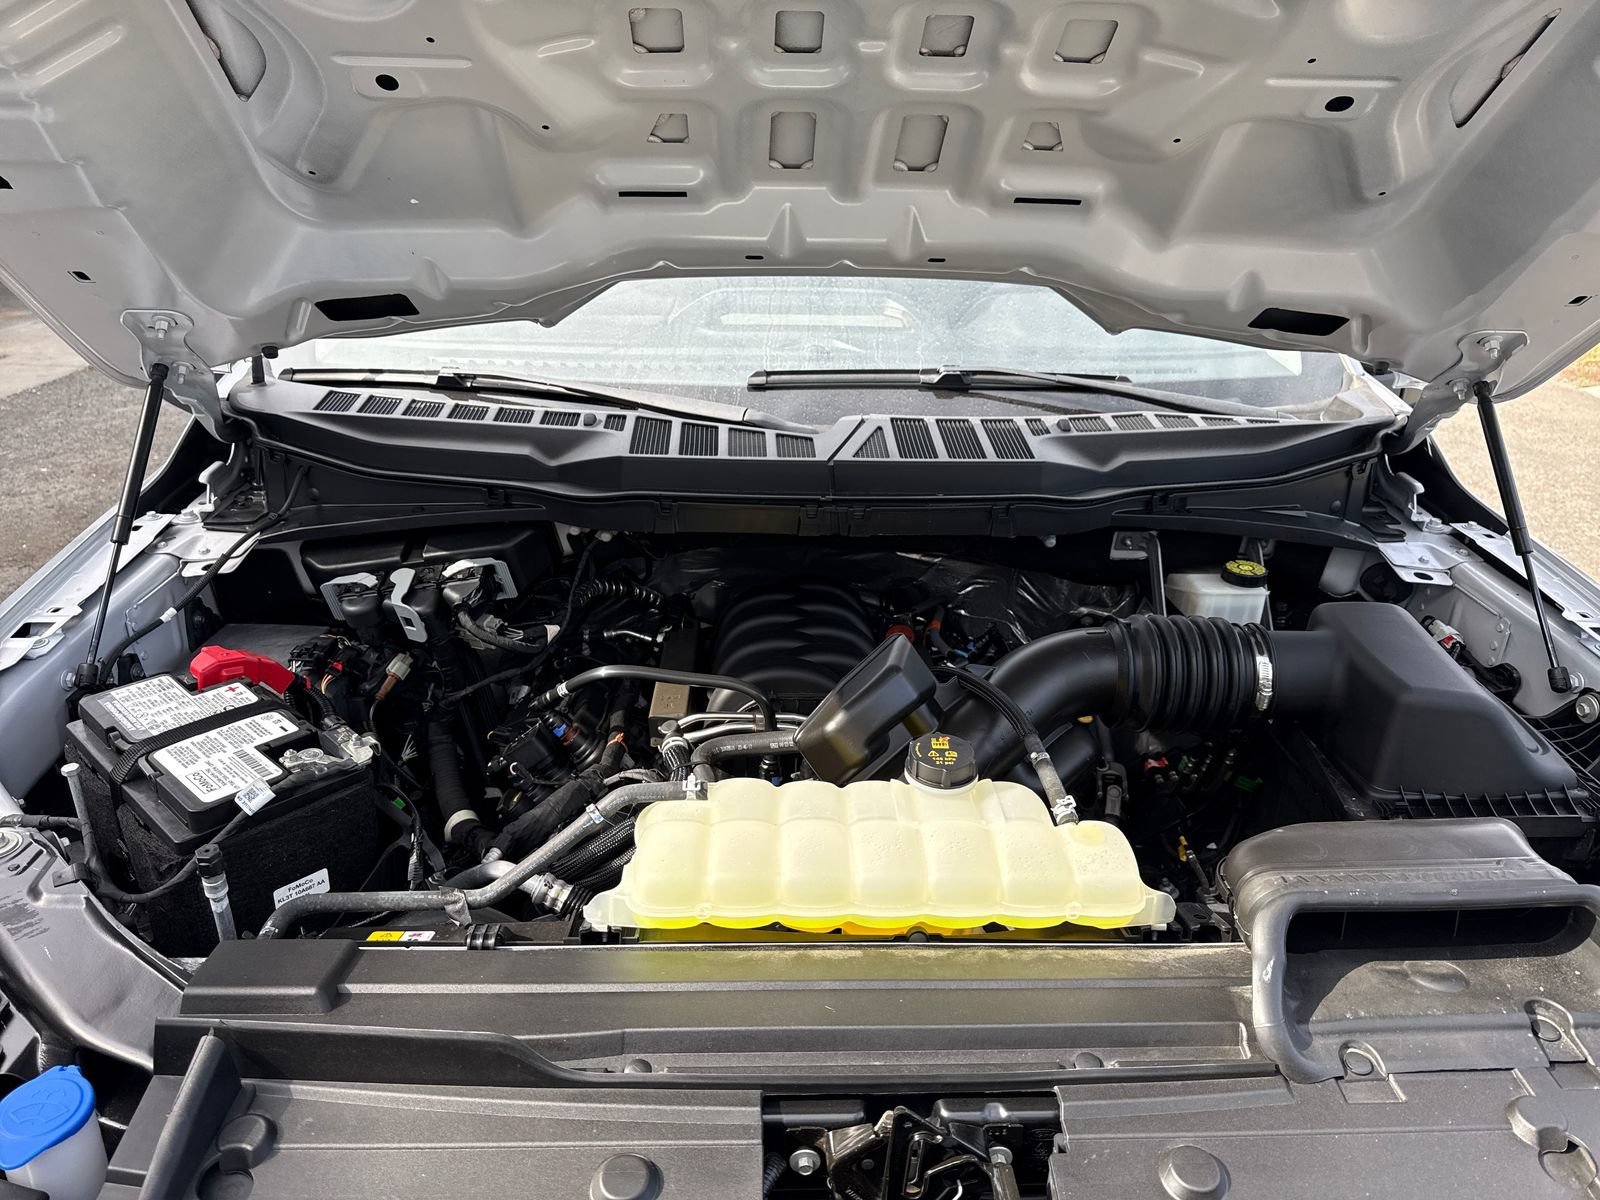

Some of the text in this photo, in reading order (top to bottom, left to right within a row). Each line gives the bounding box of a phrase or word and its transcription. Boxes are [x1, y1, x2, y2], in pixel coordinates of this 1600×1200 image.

[192, 772, 217, 793] FoMoCo
[287, 878, 314, 893] FoMoCo
[317, 879, 326, 887] AA
